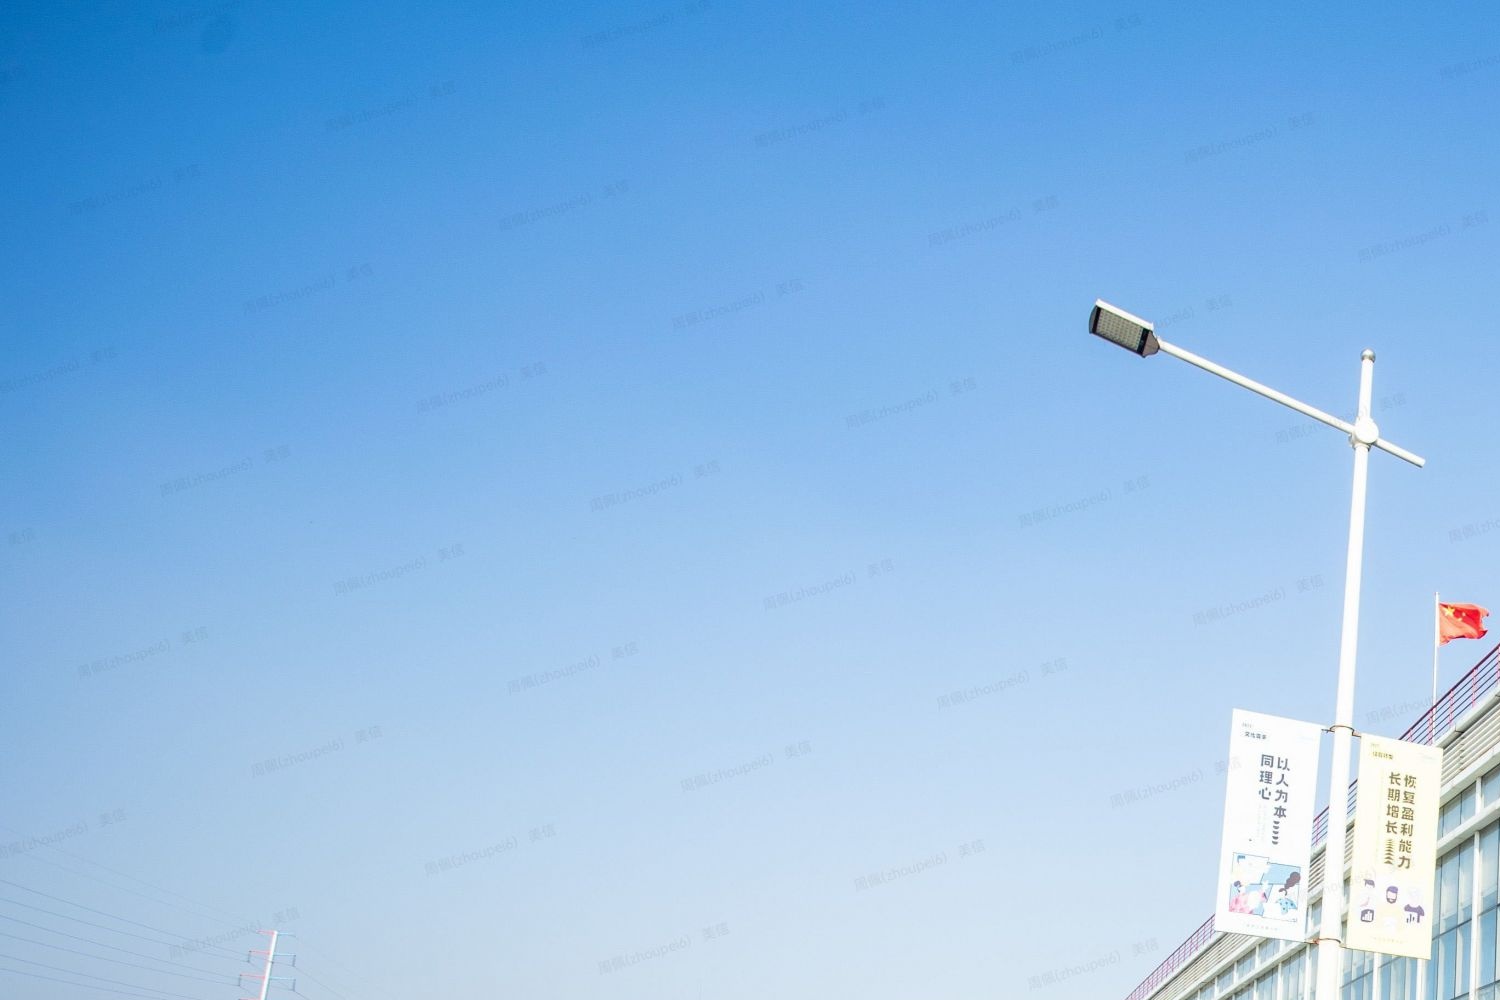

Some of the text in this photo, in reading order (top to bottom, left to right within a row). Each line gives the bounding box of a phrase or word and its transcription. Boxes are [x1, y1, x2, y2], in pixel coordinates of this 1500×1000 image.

[1258, 754, 1274, 801] 同理心
[1273, 756, 1290, 819] 以人为本
[1385, 772, 1402, 835] 长期增长
[1397, 774, 1417, 870] 恢复盈利能力
